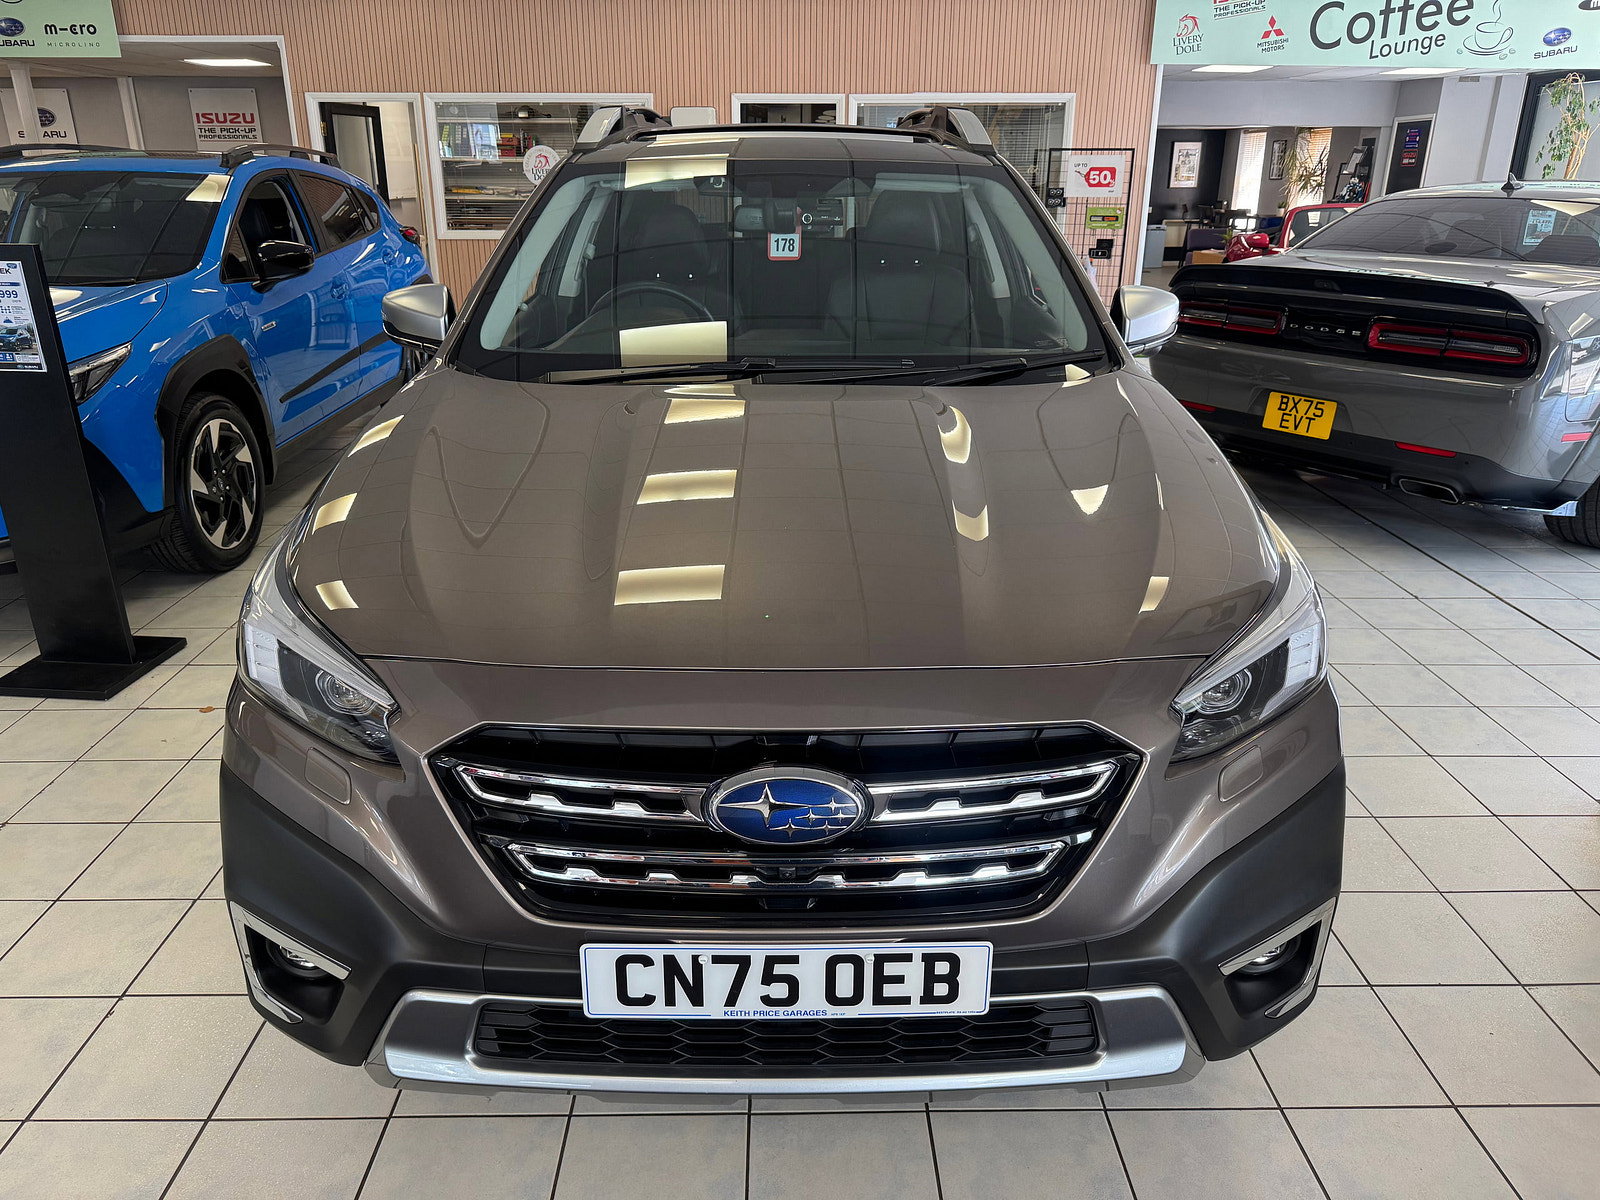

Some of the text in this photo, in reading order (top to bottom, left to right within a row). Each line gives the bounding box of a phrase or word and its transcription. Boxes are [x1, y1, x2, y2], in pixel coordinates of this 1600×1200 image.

[1213, 5, 1266, 18] PROFESSIONALS
[1214, 4, 1230, 13] THE
[1310, 0, 1474, 50] Coffee
[1172, 33, 1204, 47] LIVERY
[1257, 37, 1289, 48] MITSUBISHI
[1369, 33, 1446, 60] Lounge
[1176, 43, 1202, 55] DOLE
[1261, 44, 1285, 53] MOTORS
[1533, 45, 1578, 59] SUBARU
[195, 112, 256, 124] ISUZU
[18, 130, 67, 138] SARU
[774, 237, 795, 252] 178
[1278, 395, 1325, 418] BX75
[1279, 412, 1316, 433] EVT
[615, 952, 961, 1008] CN75 OEB
[723, 1009, 750, 1017] KEITH
[753, 1009, 780, 1017] PRICE
[782, 1009, 828, 1017] GARAGES
